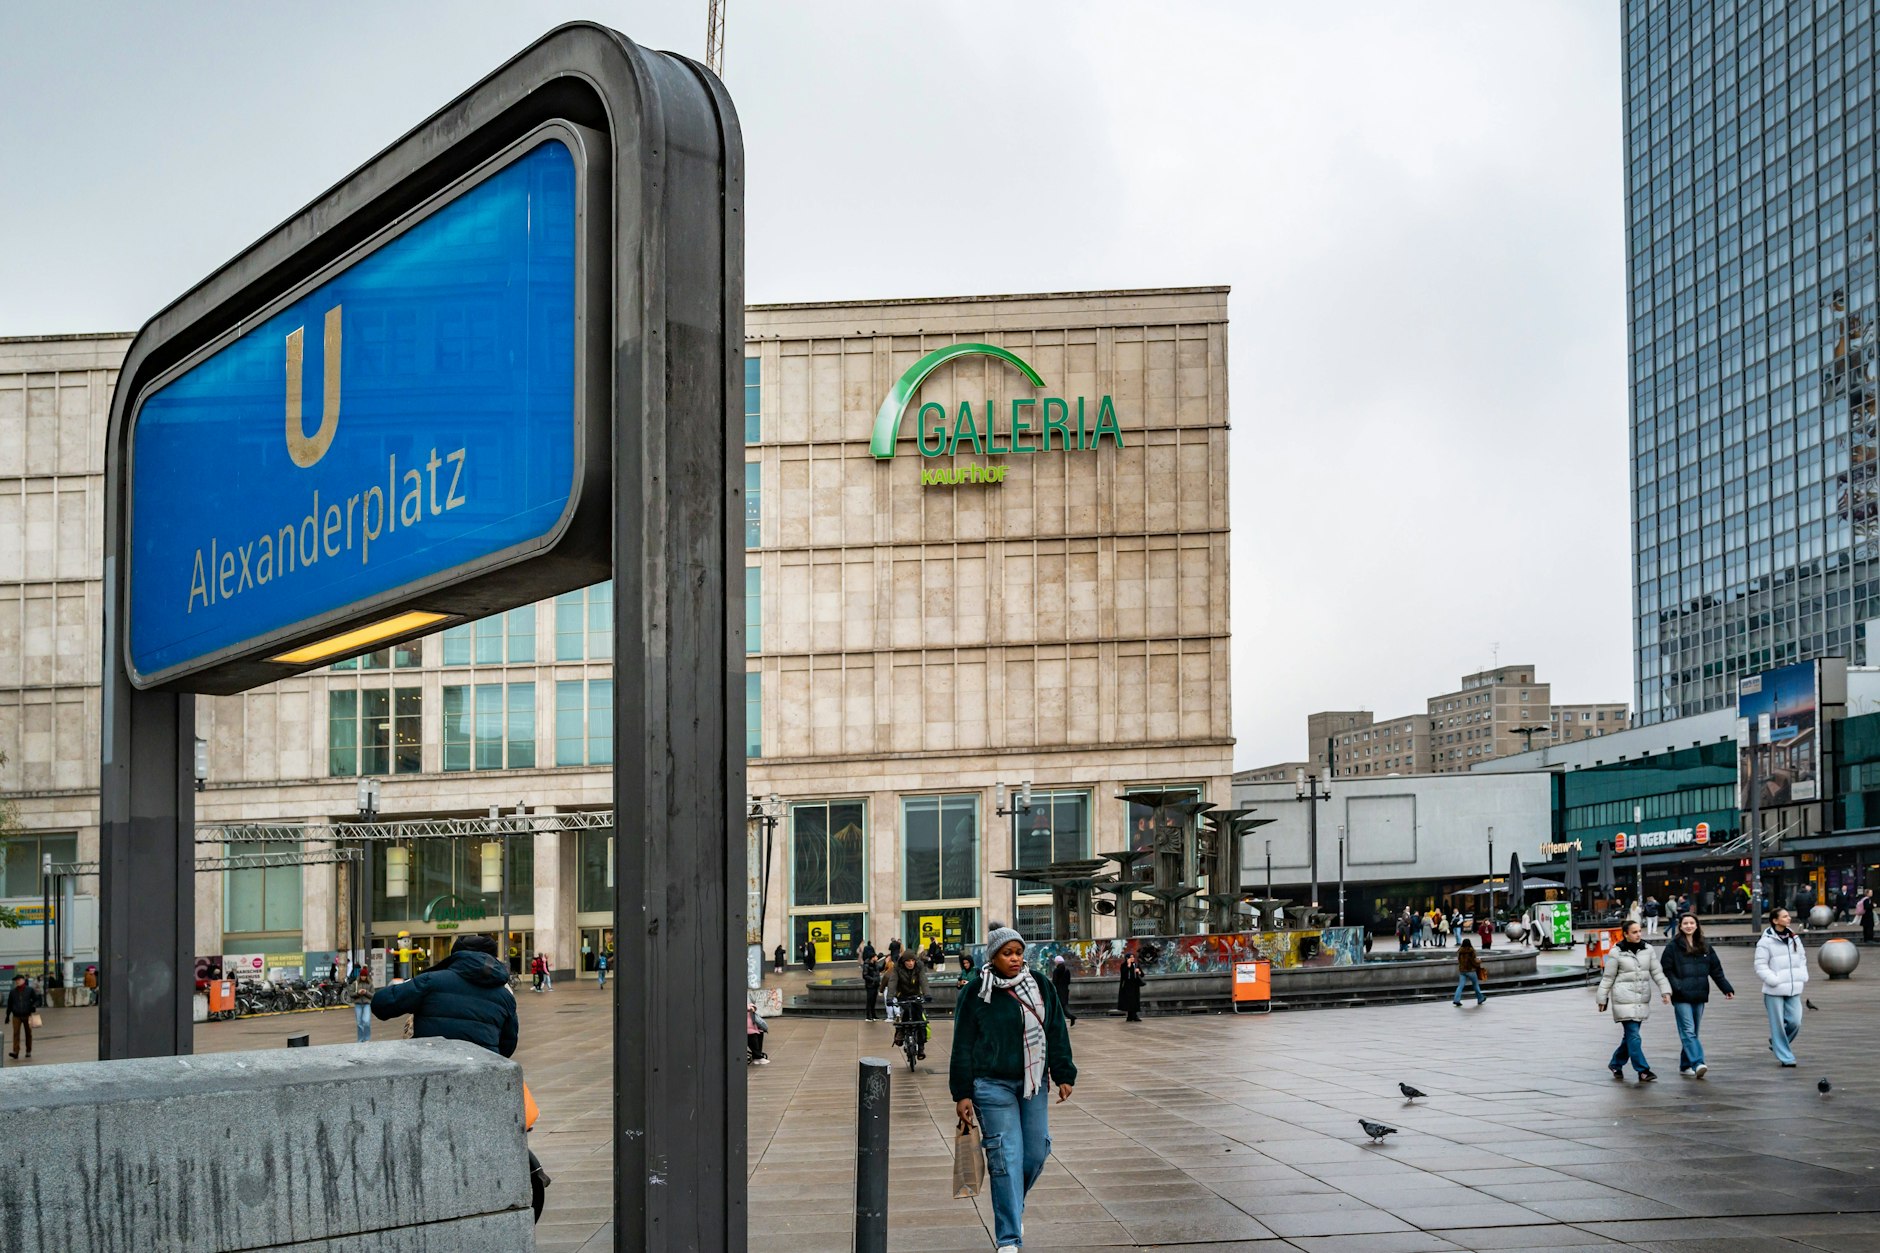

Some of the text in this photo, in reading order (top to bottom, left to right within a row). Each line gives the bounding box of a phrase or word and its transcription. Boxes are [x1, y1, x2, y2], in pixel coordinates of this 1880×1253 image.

[286, 304, 342, 468] U
[916, 394, 1126, 458] GALERIA
[187, 447, 466, 613] Alexanderplatz
[1667, 827, 1693, 845] KING
[811, 927, 822, 938] 6
[922, 922, 933, 932] 6
